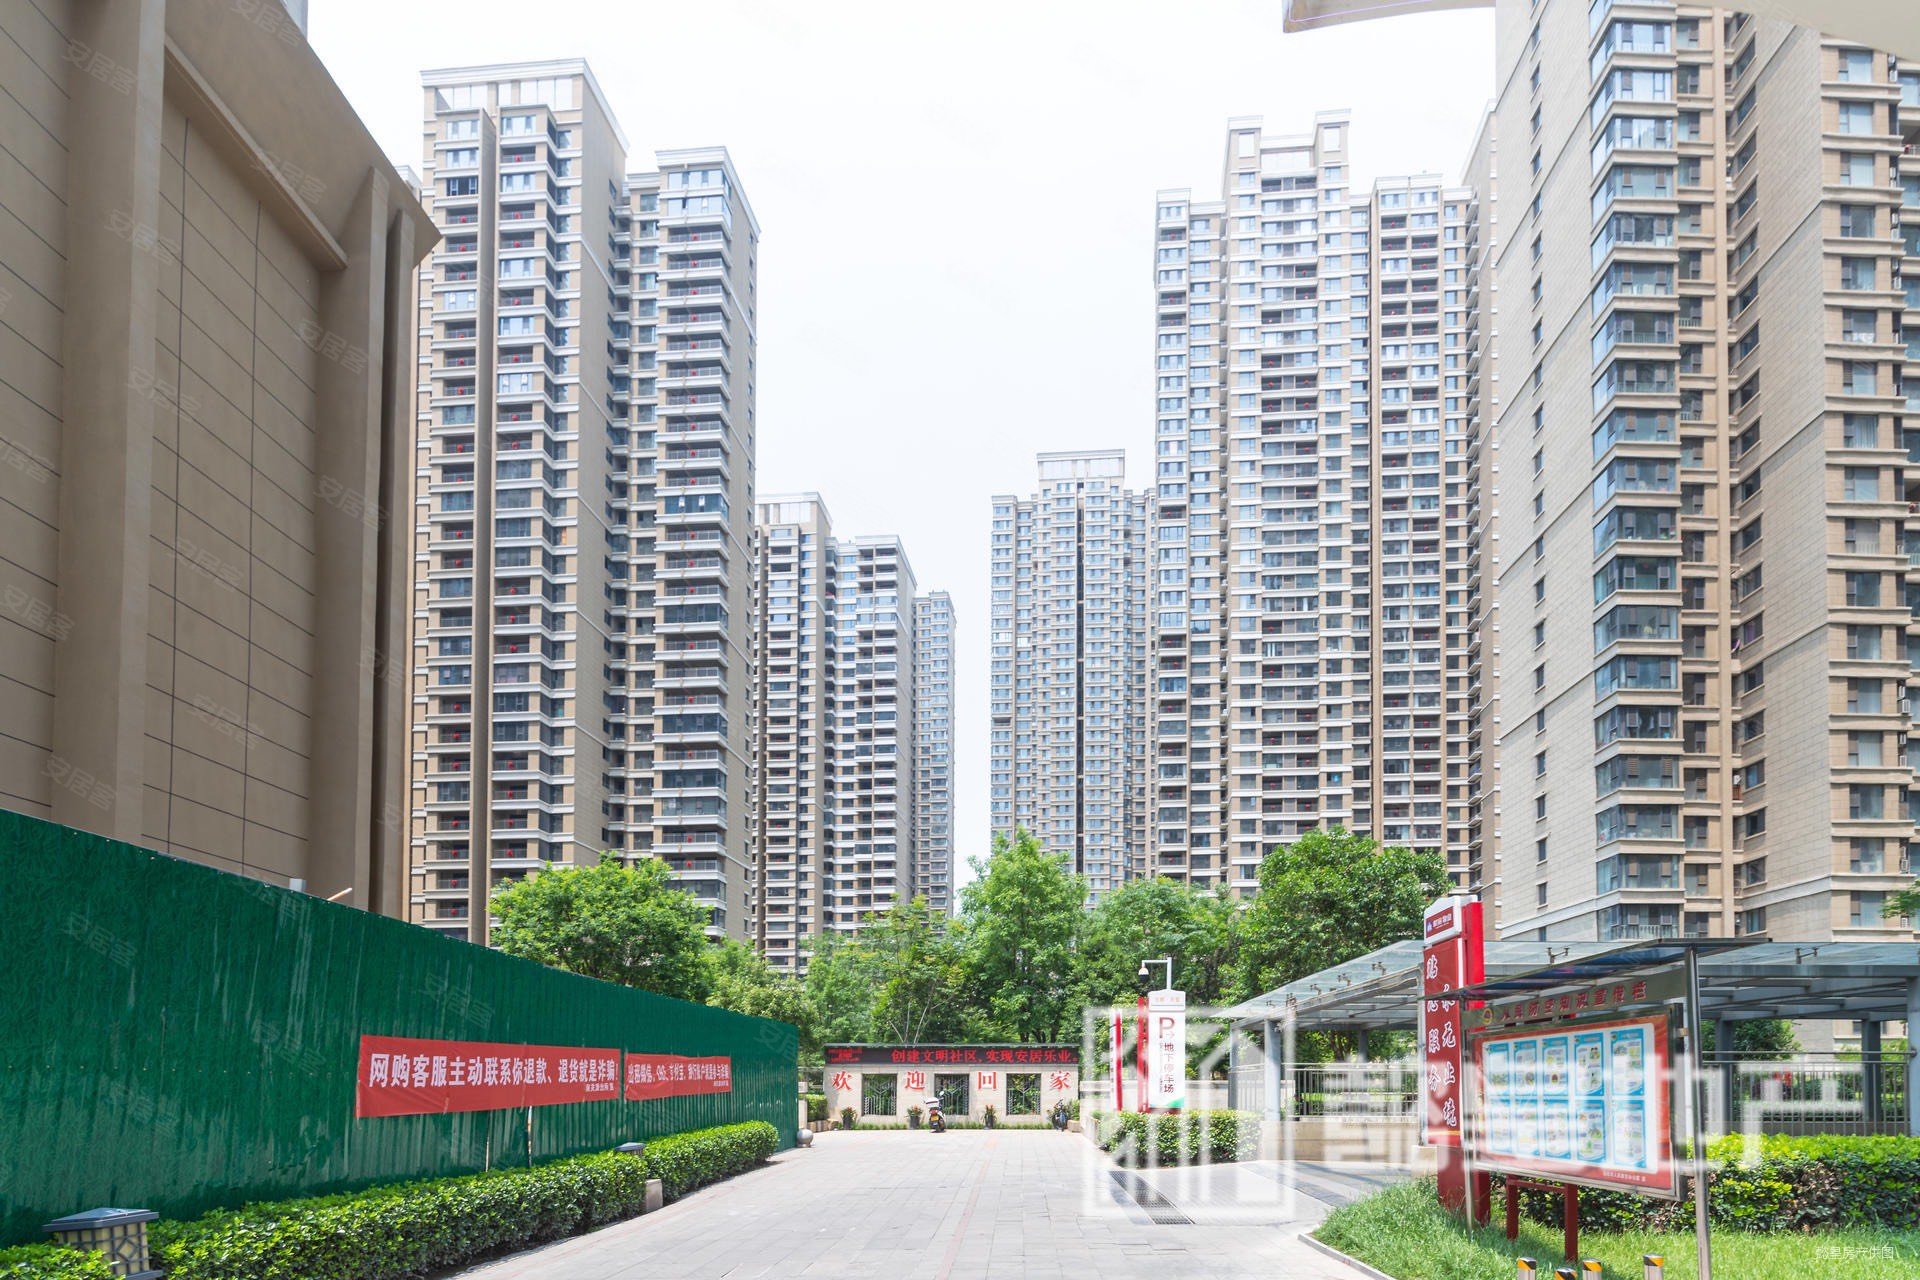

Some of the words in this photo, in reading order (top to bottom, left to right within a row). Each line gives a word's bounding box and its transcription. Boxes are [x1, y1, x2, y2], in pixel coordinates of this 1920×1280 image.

[1159, 1017, 1175, 1038] P
[1163, 1042, 1175, 1093] 地下停车场
